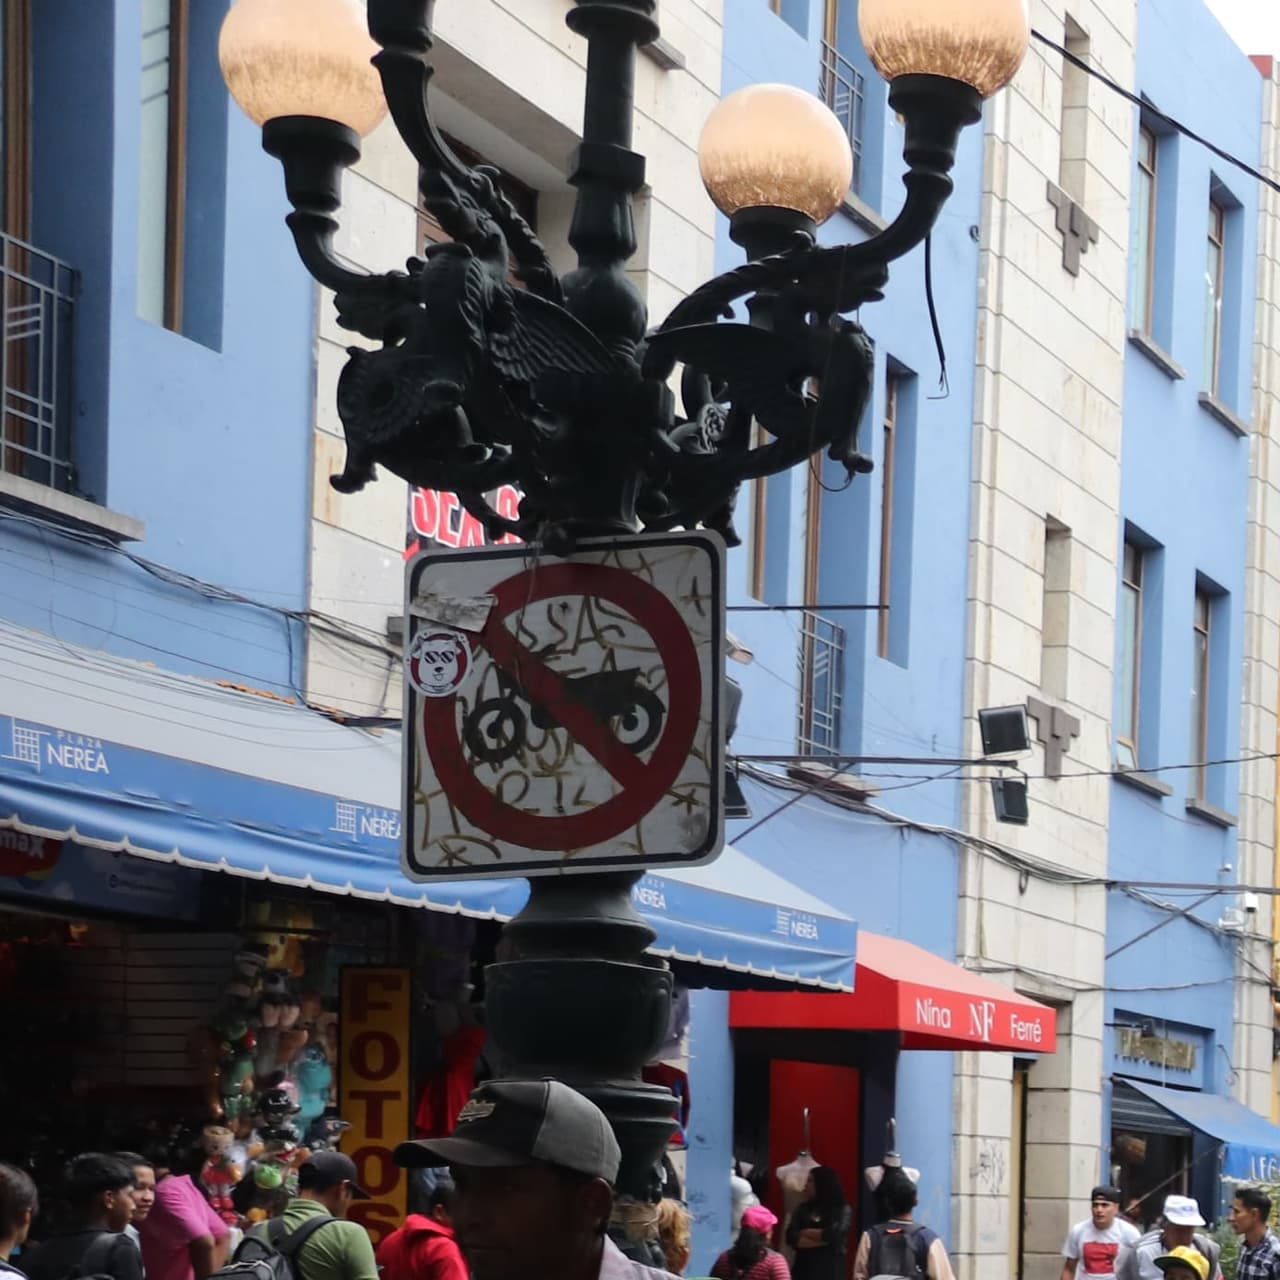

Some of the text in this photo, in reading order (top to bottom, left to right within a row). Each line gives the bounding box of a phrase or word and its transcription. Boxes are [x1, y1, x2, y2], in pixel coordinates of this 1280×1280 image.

[57, 730, 103, 749] PLAZA
[47, 742, 110, 774] NEREA
[791, 920, 819, 940] NEREA
[1009, 1013, 1042, 1043] Ferré
